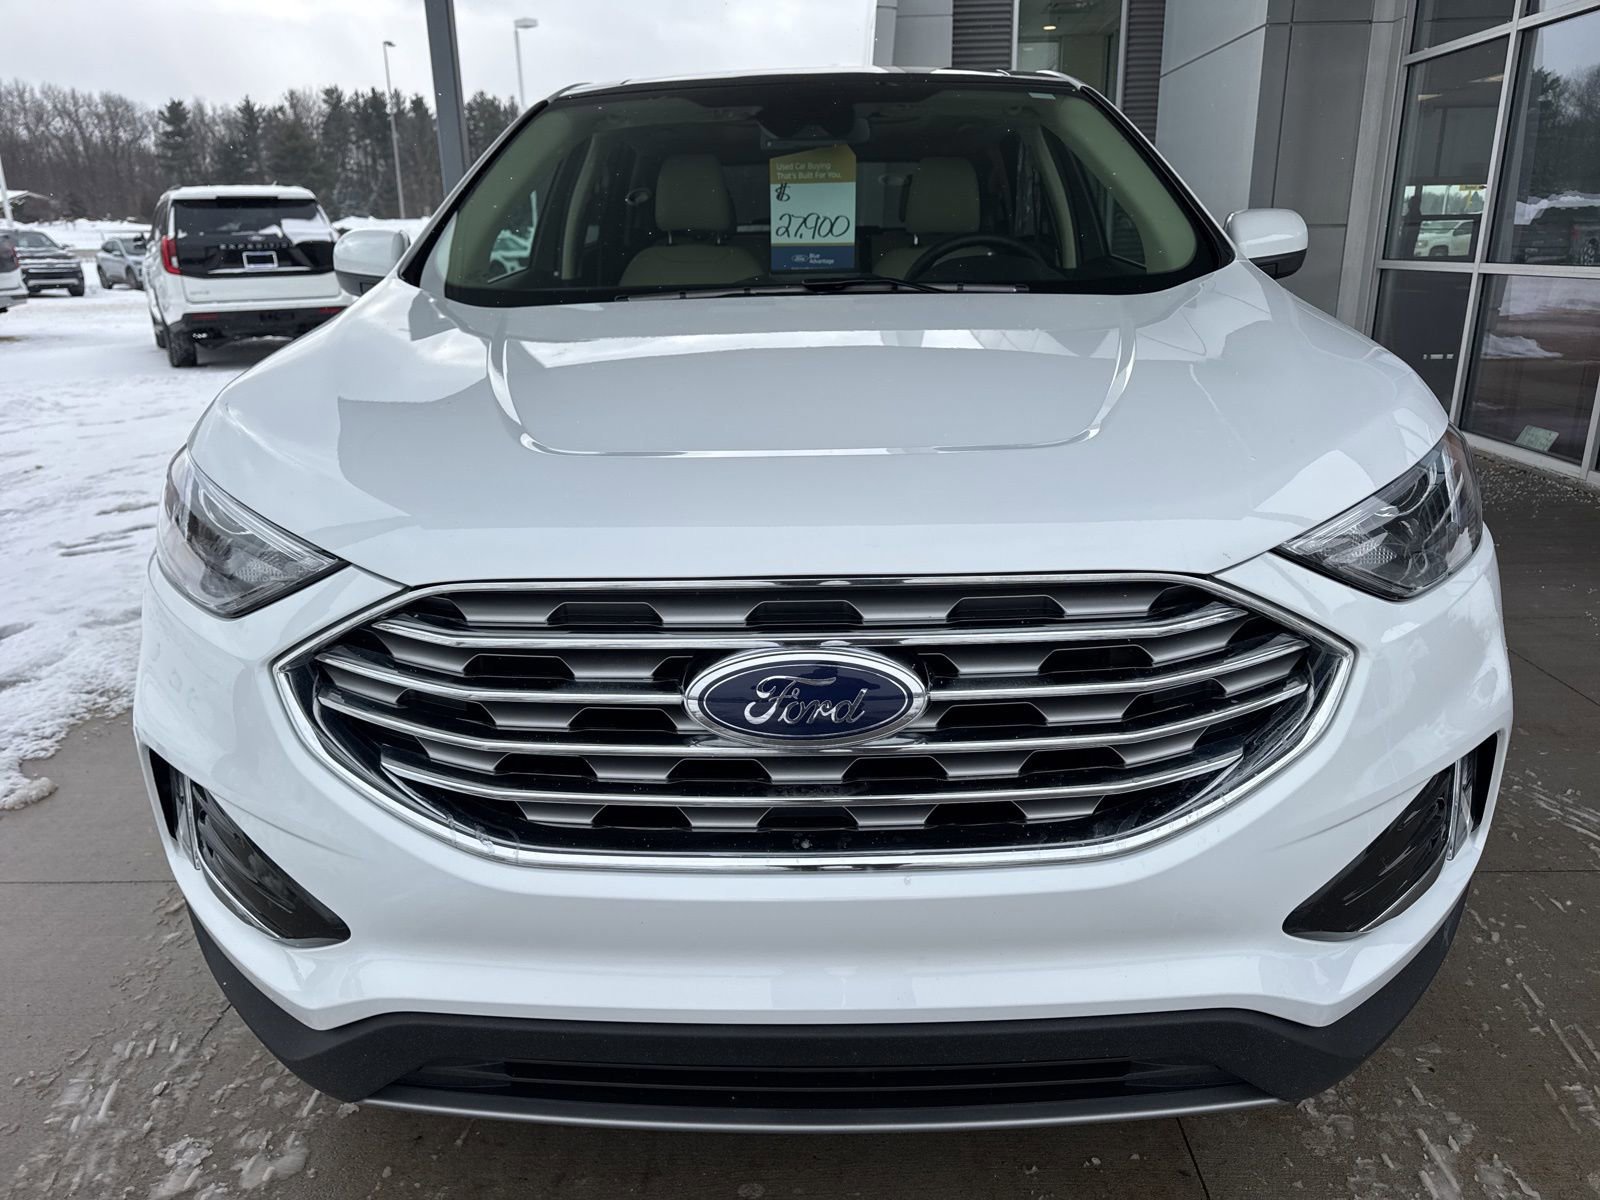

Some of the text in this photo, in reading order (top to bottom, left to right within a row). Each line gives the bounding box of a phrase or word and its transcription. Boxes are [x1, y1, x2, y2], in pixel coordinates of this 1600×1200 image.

[807, 163, 832, 171] Buying
[776, 172, 797, 180] That's
[744, 675, 868, 724] Ford
